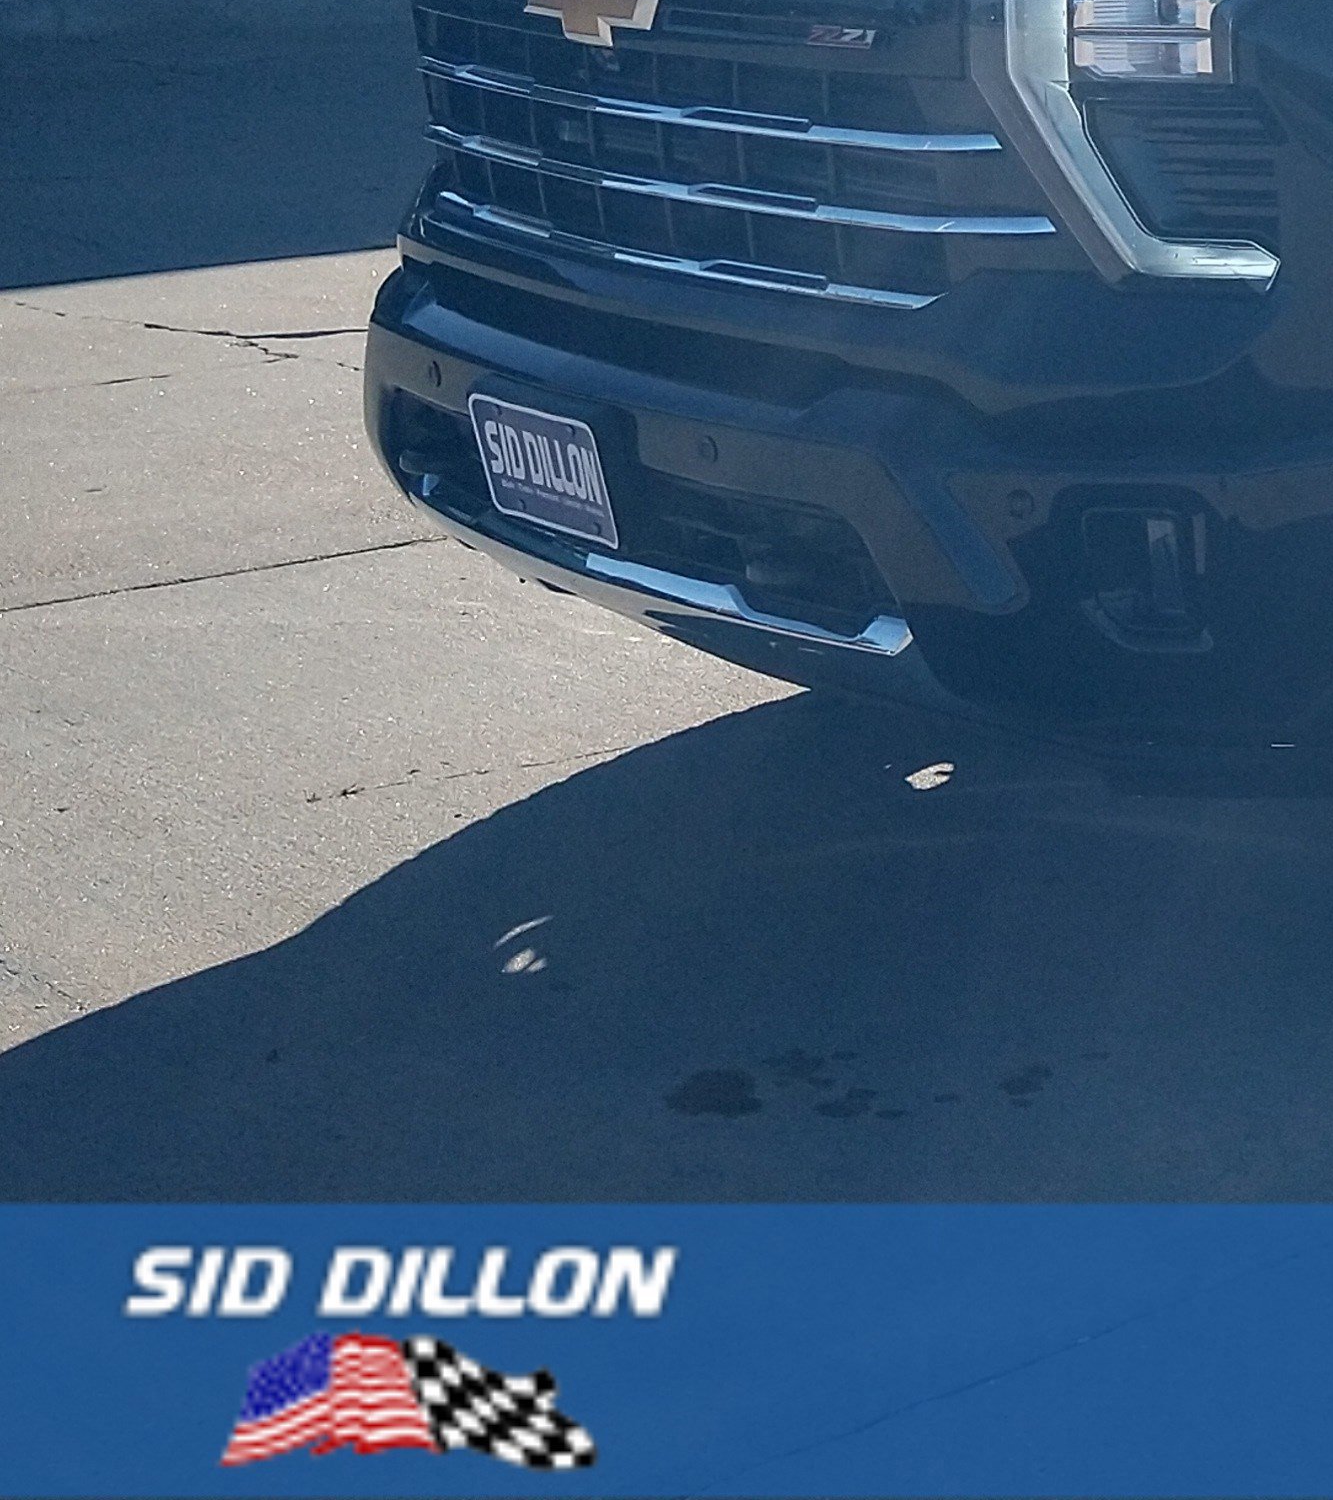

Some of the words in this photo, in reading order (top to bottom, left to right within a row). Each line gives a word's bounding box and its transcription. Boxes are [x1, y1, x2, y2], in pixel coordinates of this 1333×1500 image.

[805, 24, 877, 49] Z71
[484, 420, 526, 480] SID
[522, 430, 603, 505] DILLON
